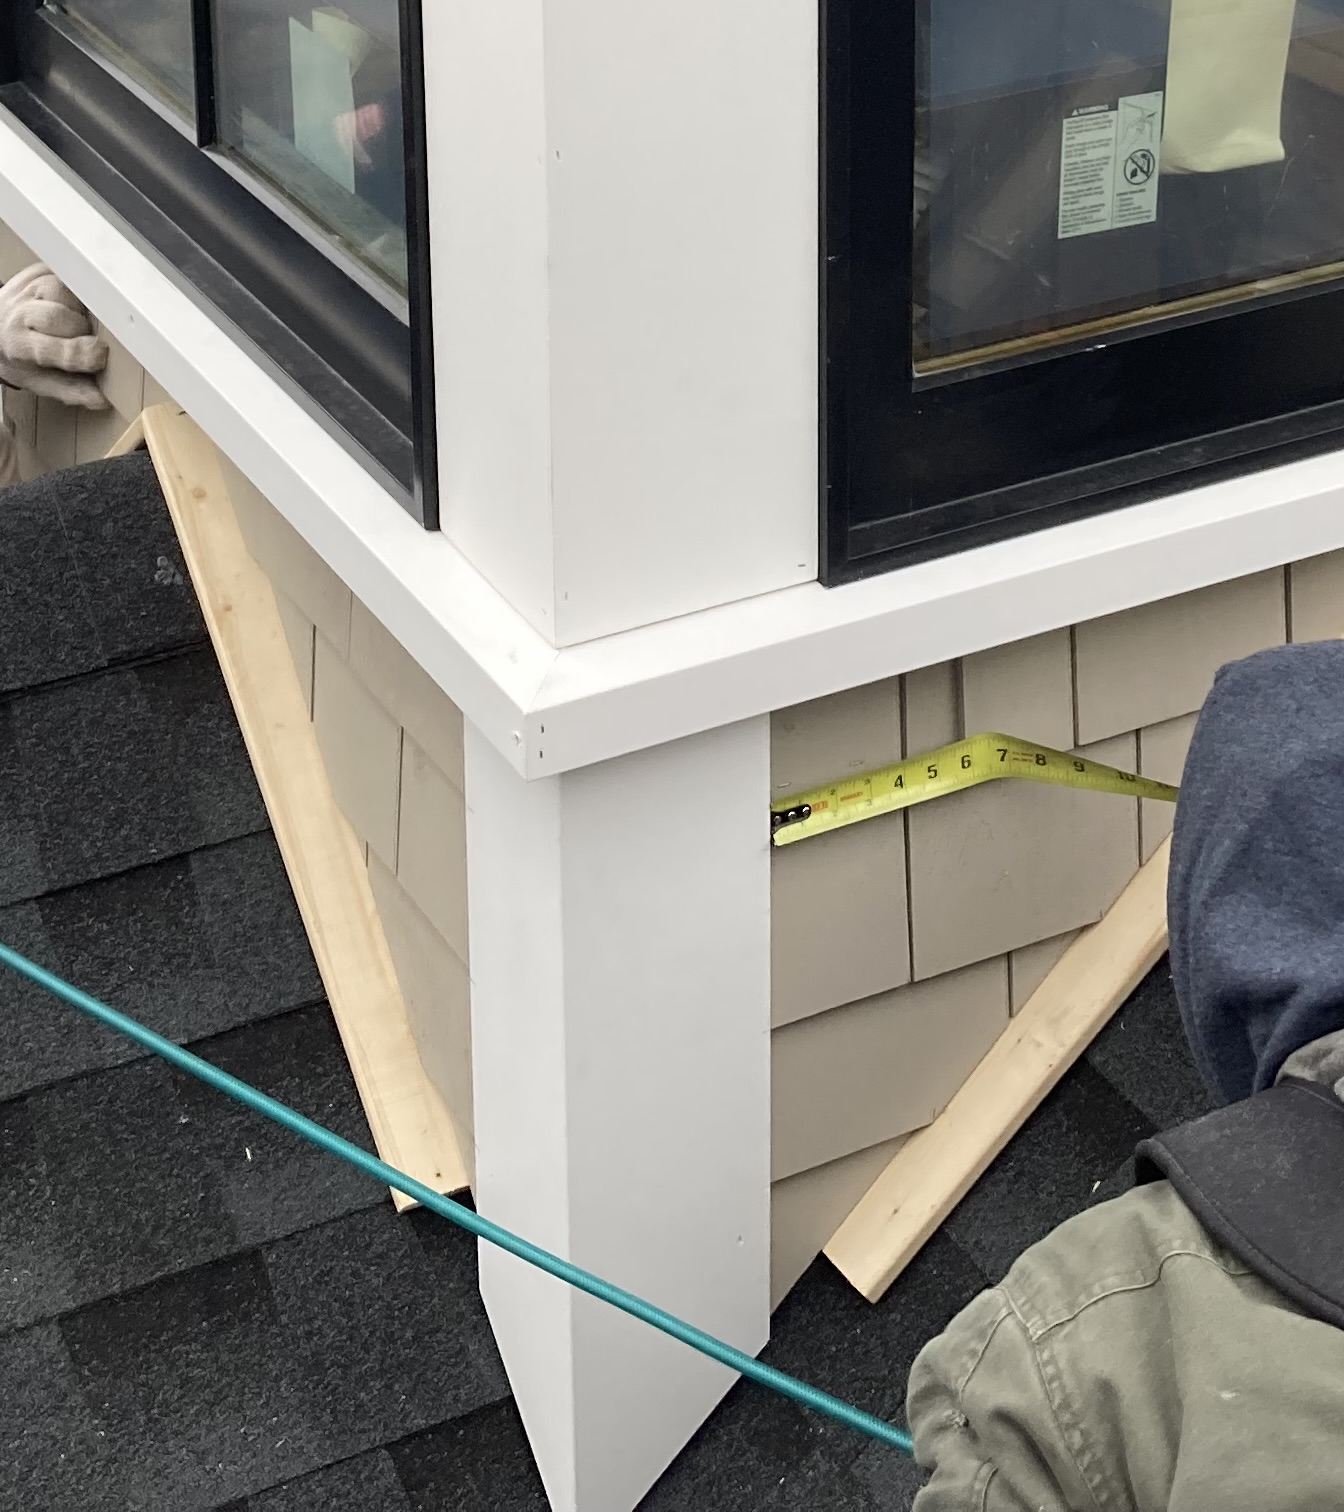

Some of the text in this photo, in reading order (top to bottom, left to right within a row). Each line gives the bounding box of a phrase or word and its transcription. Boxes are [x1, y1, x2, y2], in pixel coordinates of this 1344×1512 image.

[893, 774, 904, 789] 4
[927, 764, 938, 779] 5
[961, 754, 972, 769] 6
[996, 748, 1008, 762] 7
[1035, 753, 1047, 766] 8
[1072, 760, 1085, 772] 9
